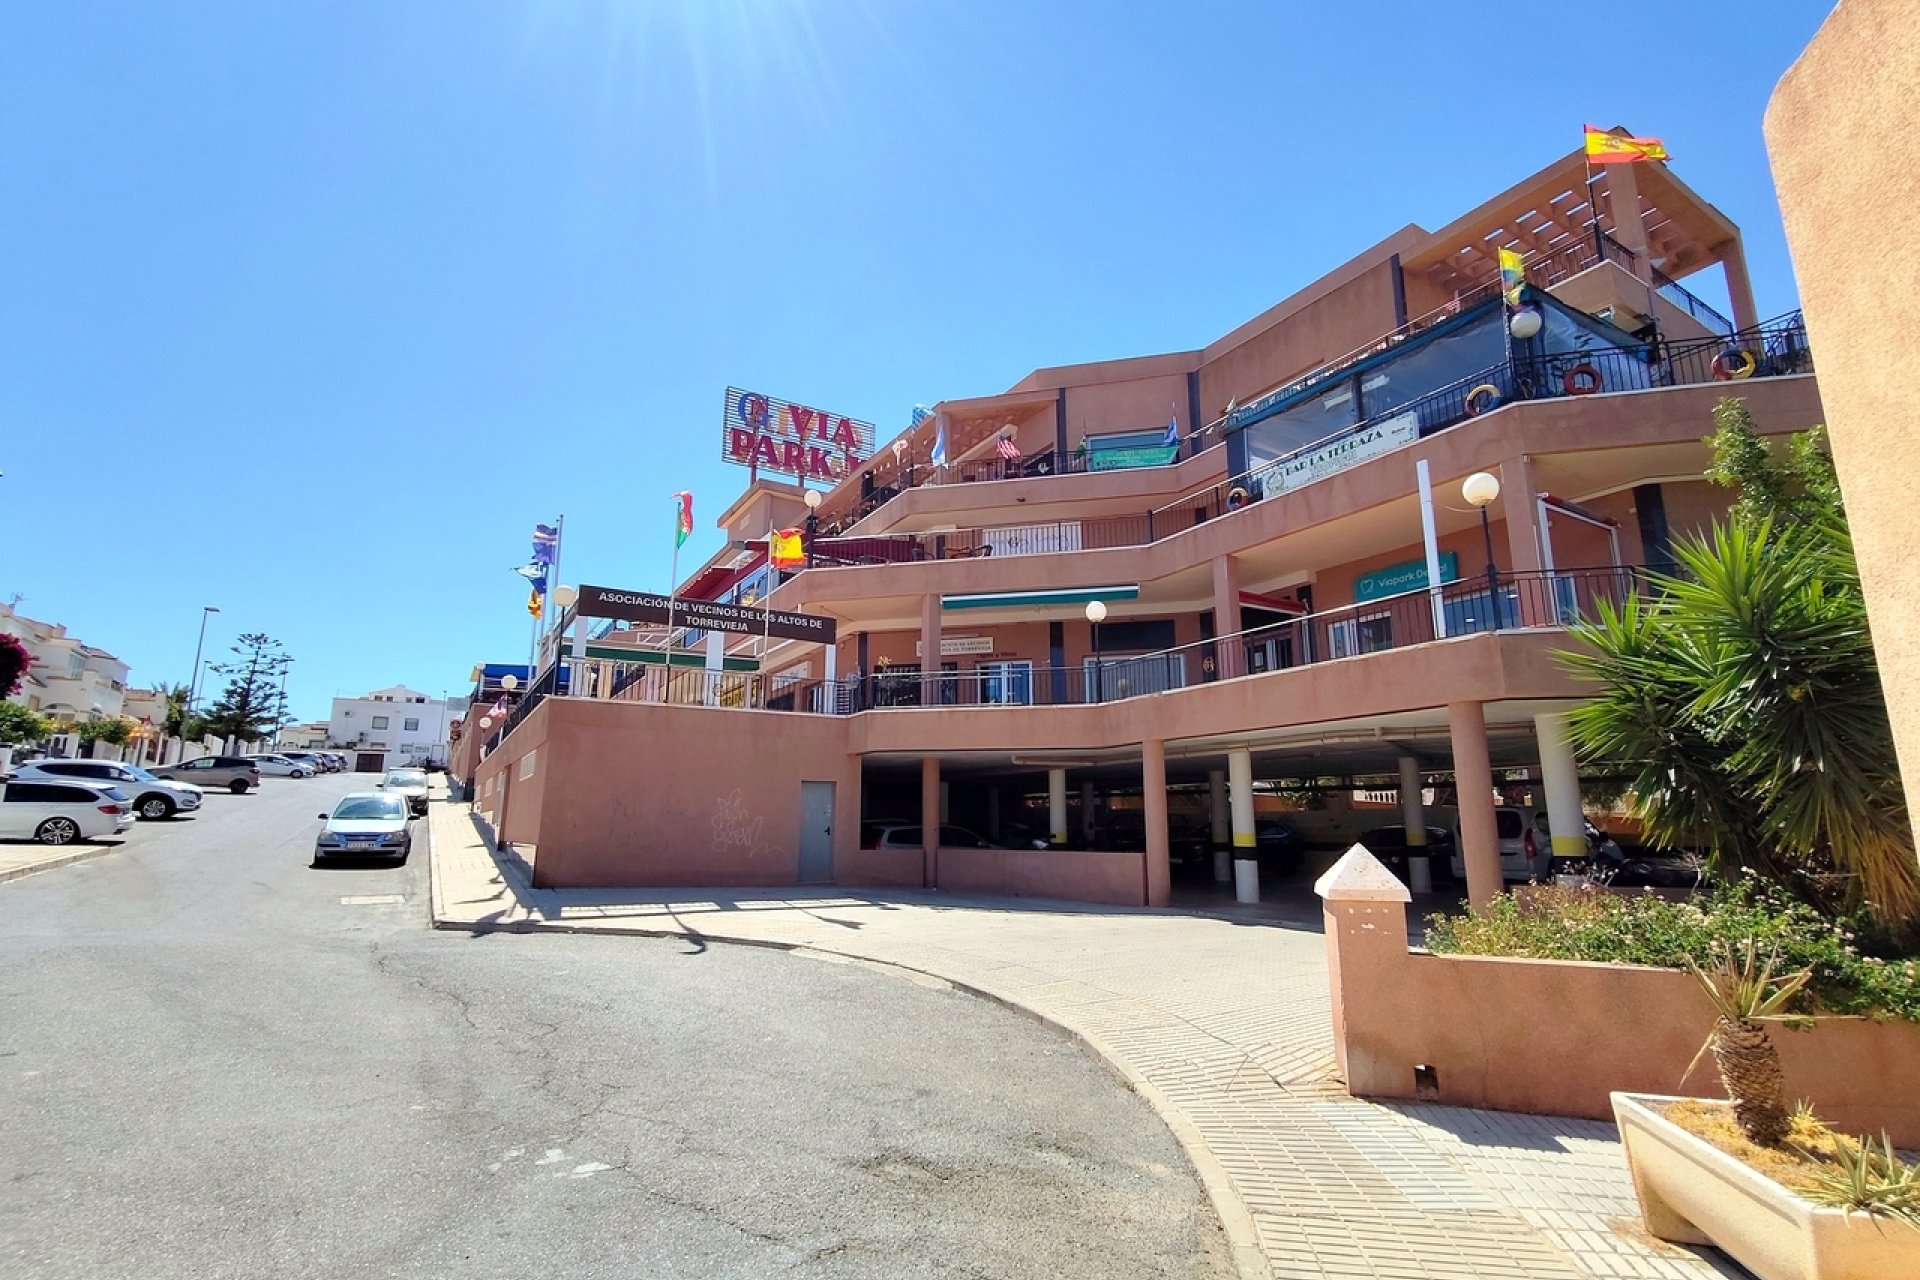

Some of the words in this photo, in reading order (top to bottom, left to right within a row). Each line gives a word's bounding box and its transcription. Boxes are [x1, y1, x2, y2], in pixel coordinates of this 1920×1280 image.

[788, 404, 858, 448] VIA
[731, 428, 834, 478] PARK
[1310, 452, 1325, 467] LA
[1328, 429, 1384, 459] TERRAZA
[1378, 572, 1414, 587] Viapark
[599, 591, 671, 609] ASOCIACIÓN
[675, 601, 690, 611] DE
[691, 604, 738, 618] VECINOS
[740, 610, 755, 620] DE
[756, 612, 776, 623] LOS
[778, 615, 808, 627] ALTOS
[809, 618, 823, 629] DE
[685, 615, 749, 632] TORREVIEJA
